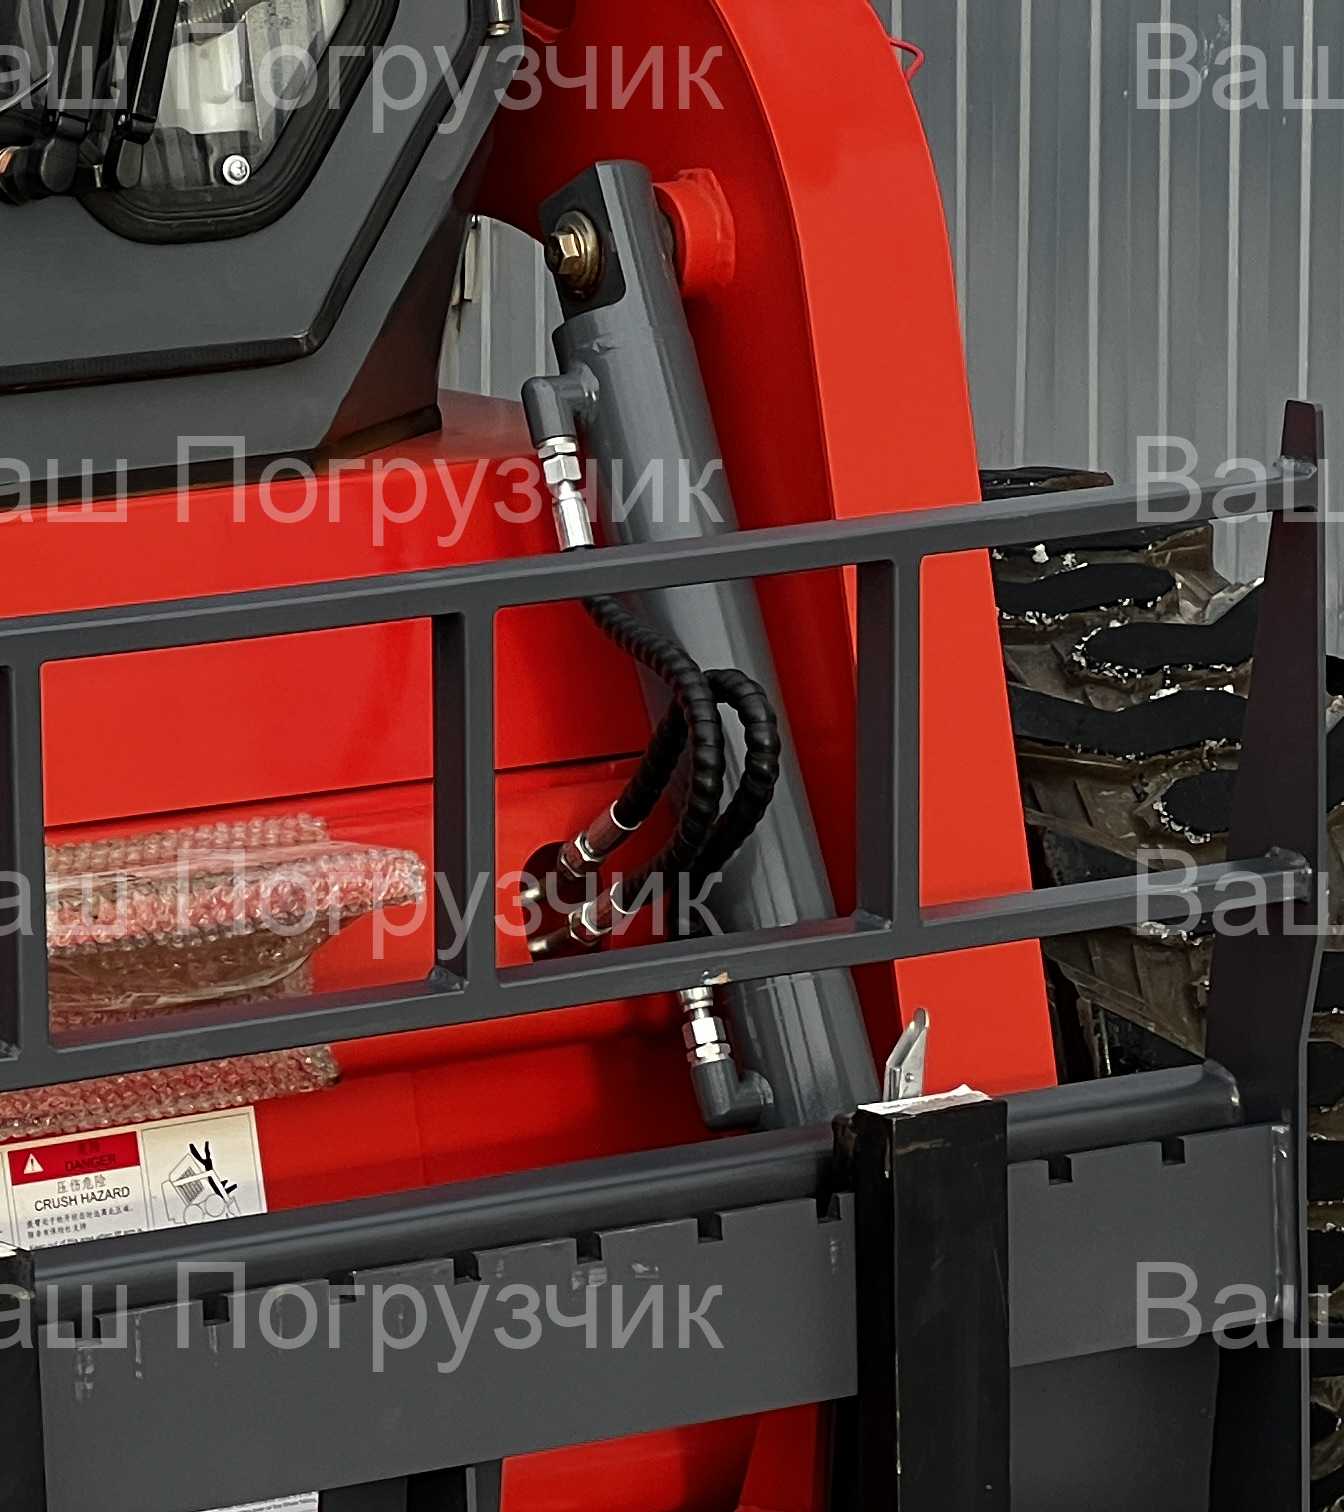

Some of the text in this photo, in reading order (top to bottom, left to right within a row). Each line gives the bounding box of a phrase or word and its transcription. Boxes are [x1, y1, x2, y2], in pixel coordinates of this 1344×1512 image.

[65, 1154, 116, 1172] DANGER
[34, 1186, 130, 1211] CRUSH HAZARD
